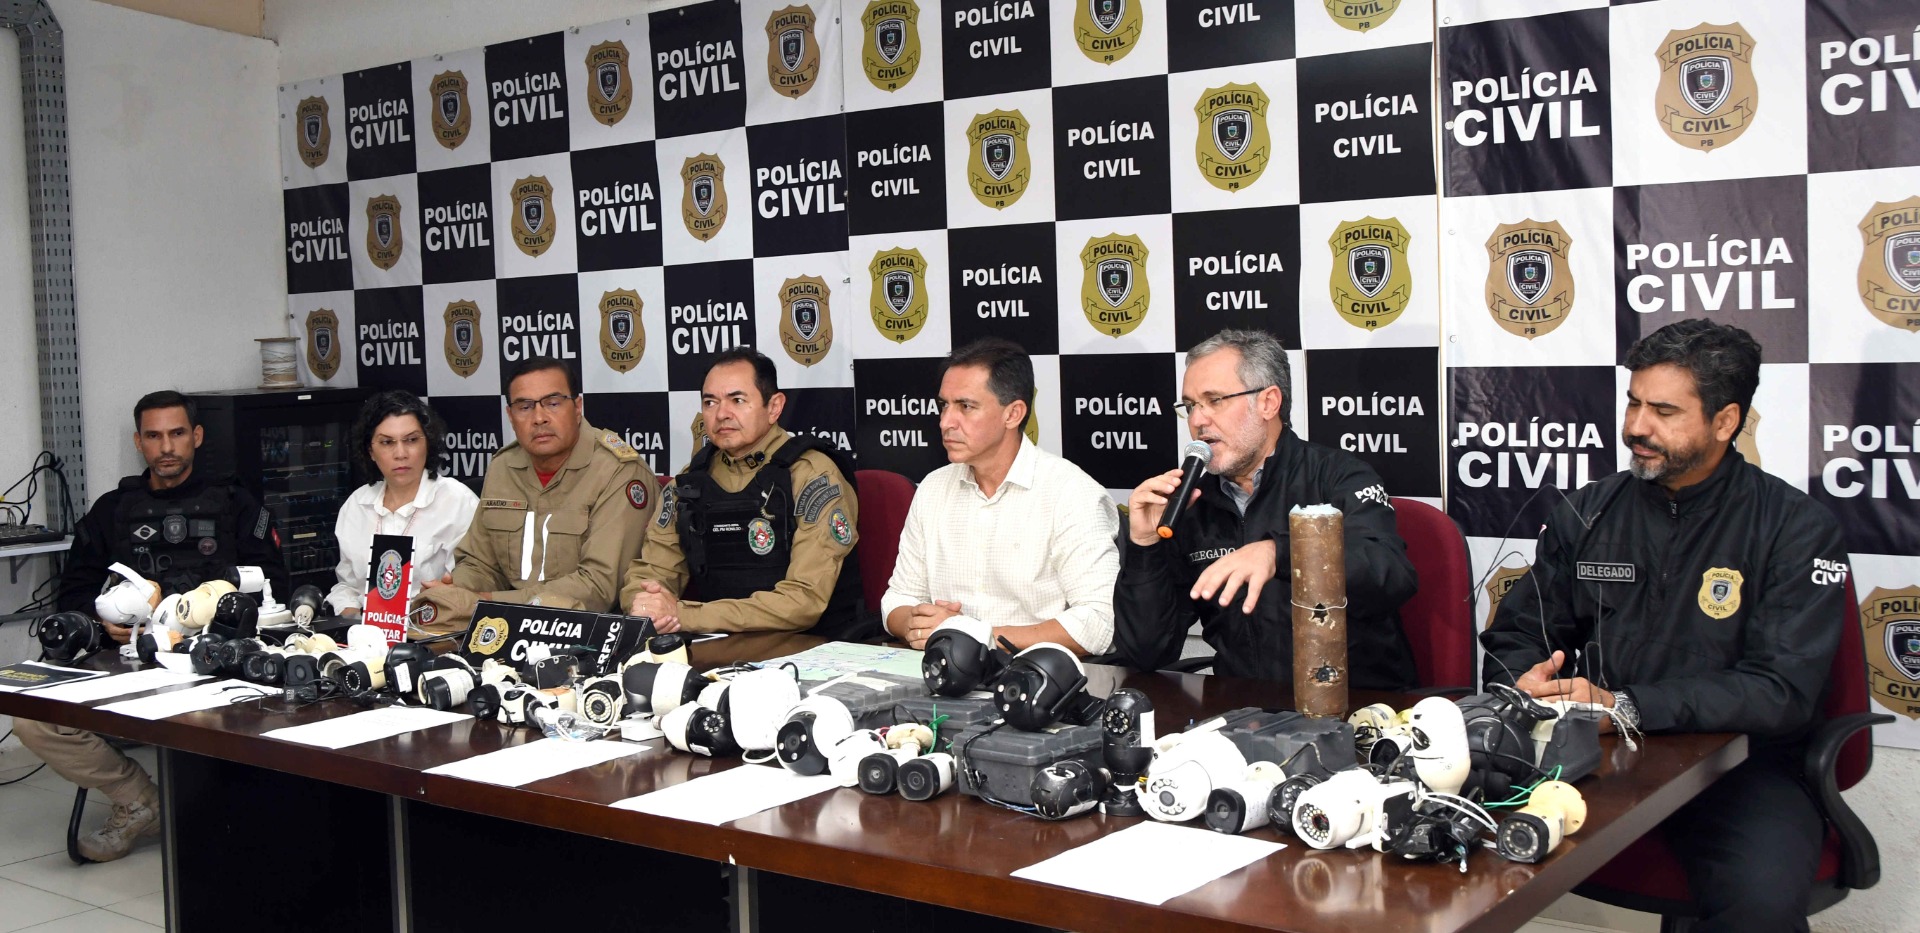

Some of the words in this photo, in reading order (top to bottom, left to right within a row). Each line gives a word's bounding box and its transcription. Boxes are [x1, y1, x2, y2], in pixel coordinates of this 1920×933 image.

[872, 4, 907, 20] POLÍCIA
[955, 0, 1034, 28] POLÍCIA
[1198, 3, 1260, 28] CIVIL
[1344, 2, 1383, 16] CIVIL
[775, 14, 807, 29] POLÍCIA
[969, 36, 1022, 58] CIVIL
[1092, 37, 1125, 50] CIVIL
[1675, 35, 1734, 56] POLÍCIA
[593, 49, 620, 62] POLÍCIA
[657, 40, 736, 71] POLÍCIA
[877, 66, 906, 78] CIVIL
[1689, 61, 1721, 71] POLÍCIA
[437, 78, 460, 90] POLÍCIA
[492, 72, 561, 99] POLÍCIA
[659, 63, 740, 101] CIVIL
[780, 74, 807, 84] CIVIL
[1452, 67, 1597, 106] POLÍCIA
[350, 98, 408, 123] POLÍCIA
[494, 93, 564, 127] CIVIL
[600, 104, 621, 113] CIVIL
[1209, 92, 1254, 109] POLÍCIA
[1315, 94, 1418, 123] POLÍCIA
[979, 117, 1016, 133] POLÍCIA
[1220, 114, 1244, 122] POLÍCIA
[1453, 100, 1600, 146] CIVIL
[1682, 117, 1731, 133] CIVIL
[350, 118, 410, 149] CIVIL
[442, 129, 462, 138] CIVIL
[1068, 120, 1154, 147] POLÍCIA
[1700, 139, 1714, 147] PB
[857, 144, 931, 168] POLÍCIA
[1333, 134, 1401, 158] CIVIL
[690, 161, 715, 174] POLÍCIA
[756, 158, 842, 187] POLÍCIA
[1084, 158, 1140, 180] CIVIL
[1215, 164, 1251, 176] CIVIL
[519, 183, 544, 194] POLÍCIA
[579, 181, 654, 207] POLÍCIA
[871, 178, 920, 198] CIVIL
[984, 184, 1014, 196] CIVIL
[758, 183, 845, 219] CIVIL
[424, 201, 488, 224] POLÍCIA
[581, 205, 656, 236] CIVIL
[290, 216, 344, 238] POLÍCIA
[694, 219, 715, 228] CIVIL
[426, 222, 490, 251] CIVIL
[524, 236, 545, 244] CIVIL
[1345, 226, 1393, 243] POLÍCIA
[1503, 230, 1554, 247] POLÍCIA
[292, 237, 348, 263] CIVIL
[1094, 242, 1134, 257] POLÍCIA
[1515, 255, 1543, 263] POLÍCIA
[1627, 234, 1793, 270] POLÍCIA
[880, 254, 914, 268] POLÍCIA
[1189, 251, 1283, 276] POLÍCIA
[962, 264, 1042, 286] POLÍCIA
[788, 284, 819, 296] POLÍCIA
[1627, 270, 1795, 313] CIVIL
[607, 296, 634, 308] POLÍCIA
[977, 300, 1029, 318] CIVIL
[1206, 290, 1268, 311] CIVIL
[1351, 301, 1390, 314] CIVIL
[451, 306, 474, 317] POLÍCIA
[502, 310, 574, 333] POLÍCIA
[671, 299, 748, 324] POLÍCIA
[1099, 311, 1132, 322] CIVIL
[1509, 309, 1551, 321] CIVIL
[360, 319, 419, 340] POLÍCIA
[885, 319, 913, 329] CIVIL
[503, 334, 576, 361] CIVIL
[672, 325, 750, 354] CIVIL
[795, 343, 819, 353] CIVIL
[361, 341, 421, 367] CIVIL
[455, 358, 474, 366] CIVIL
[611, 352, 634, 360] CIVIL
[866, 395, 939, 415] POLÍCIA
[1076, 393, 1162, 415] POLÍCIA
[1322, 392, 1424, 416] POLÍCIA
[446, 429, 498, 450] OLÍCIA
[625, 428, 663, 450] ÍCIA
[879, 430, 928, 447] CIVIL
[1091, 431, 1147, 450] CIVIL
[1458, 416, 1604, 448] POLÍCIA
[1340, 433, 1407, 453] CIVIL
[1458, 451, 1598, 490] CIVIL
[1580, 565, 1632, 578] DELEGADO
[368, 611, 402, 624] POLÍCIA
[519, 618, 582, 638] POLÍCIA
